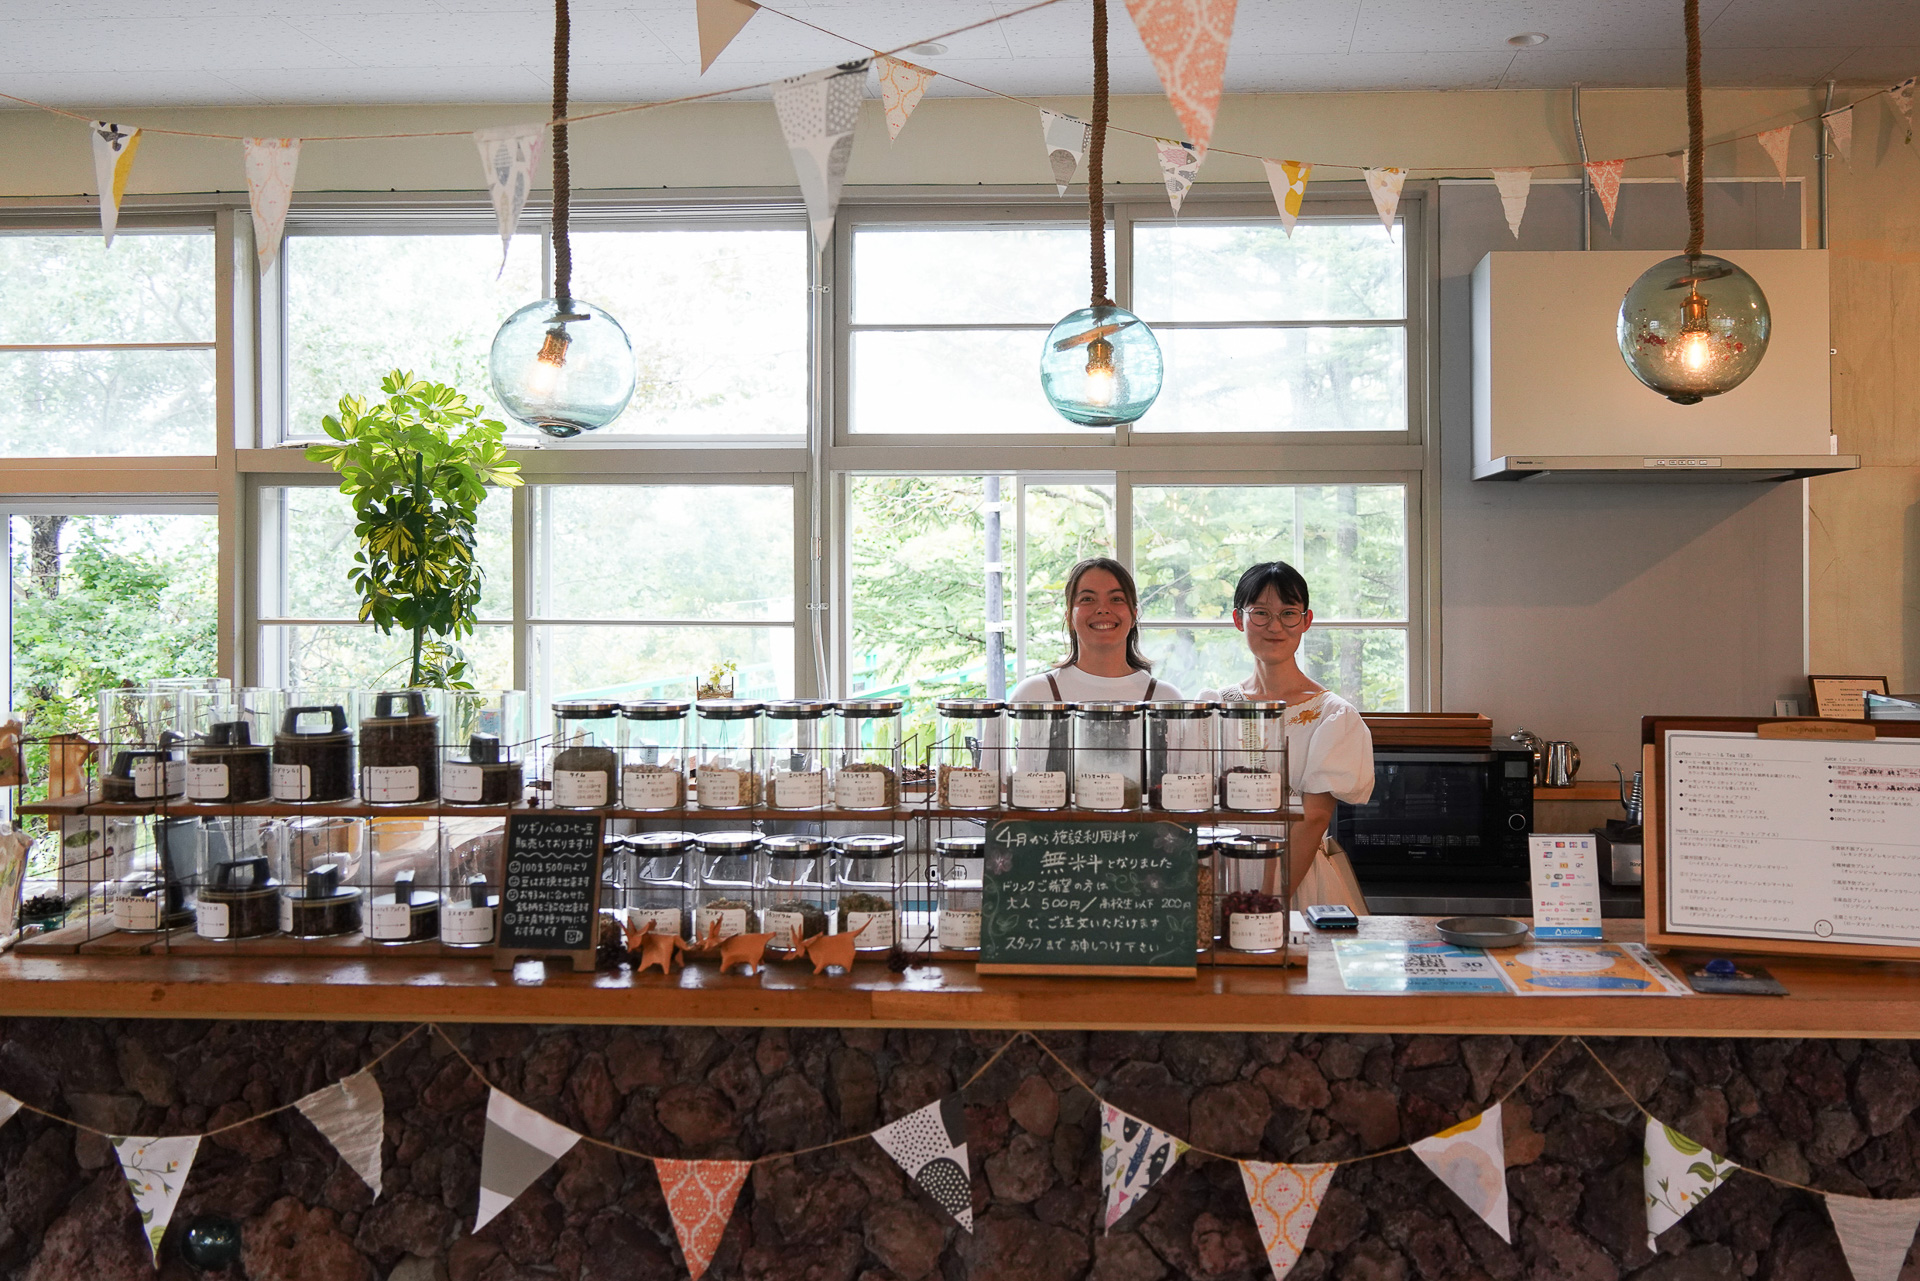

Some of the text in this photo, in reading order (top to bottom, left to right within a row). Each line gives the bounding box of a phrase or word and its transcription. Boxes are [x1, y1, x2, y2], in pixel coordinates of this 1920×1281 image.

[518, 821, 594, 836] ツギノバのコーヒー豆
[996, 826, 1138, 848] 4月から施設利用料が
[1040, 851, 1173, 875] 無料となりました
[1002, 878, 1109, 893] ドリンクご希望の方は
[1006, 897, 1031, 910] 大人
[514, 926, 557, 937] おすすめです
